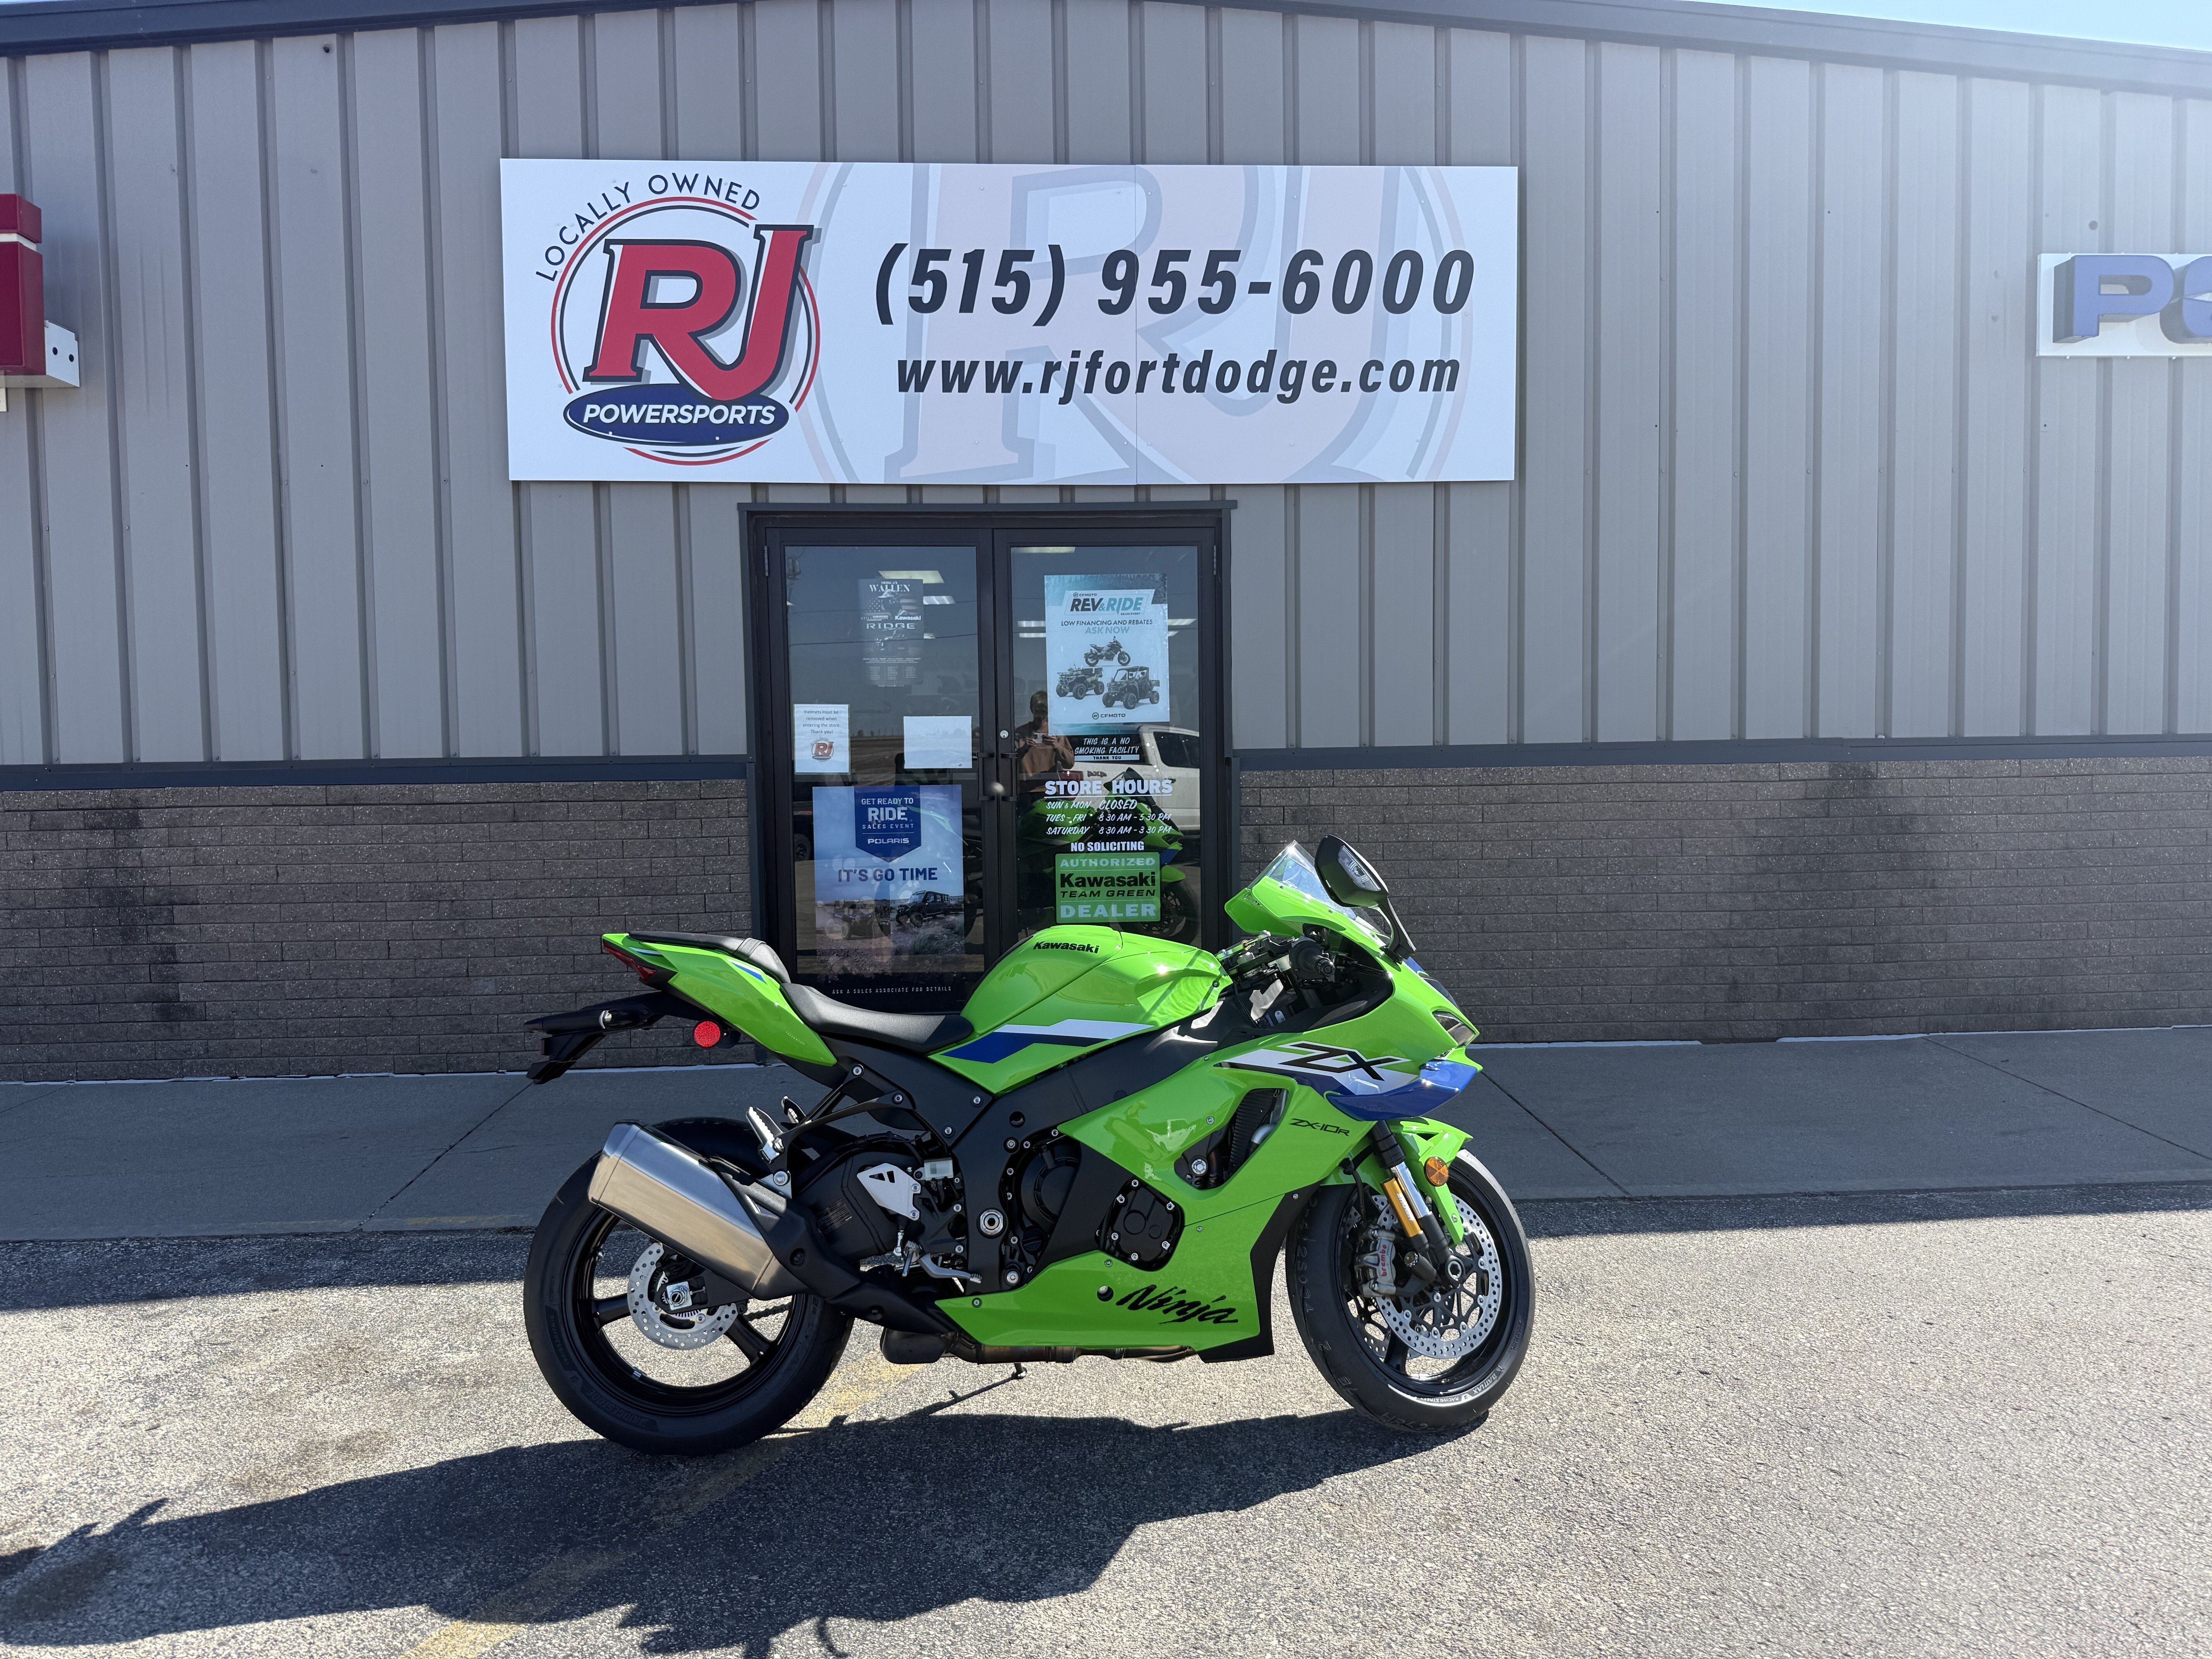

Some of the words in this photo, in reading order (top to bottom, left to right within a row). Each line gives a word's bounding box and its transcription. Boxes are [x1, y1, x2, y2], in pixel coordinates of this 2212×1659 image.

[536, 182, 632, 282] LOCALLY
[649, 173, 760, 210] OWNED
[876, 243, 1065, 326] (515)
[1098, 249, 1474, 315] 955-6000
[582, 224, 814, 404] RJ
[898, 349, 1460, 405] www.rjfortdodge.com
[583, 404, 776, 425] POWERSPORTS
[814, 741, 834, 757] RJ
[1109, 746, 1139, 754] FACILITY
[1045, 780, 1102, 795] STORE
[1112, 779, 1173, 794] HOURS
[1046, 801, 1064, 809] SUN
[1099, 799, 1138, 810] CLOSED
[868, 807, 908, 822] RIDE
[1046, 814, 1065, 822] TUES
[1073, 814, 1087, 822] FRI
[1117, 813, 1132, 821] AM
[1046, 826, 1091, 835] SATURDAY
[1117, 826, 1132, 834] AM
[1070, 842, 1085, 852] NO
[1087, 841, 1144, 852] SOLICITING
[1060, 857, 1156, 867] AUTHORIZED
[838, 869, 869, 883] IT'S
[873, 868, 895, 881] GO
[899, 867, 938, 881] TIME
[1060, 871, 1156, 888] Kawasaki
[1060, 903, 1156, 918] DEALER
[1033, 941, 1100, 954] Kawasaki
[1278, 1042, 1403, 1082] ZX
[1290, 1118, 1351, 1137] ZX-10R
[1116, 1284, 1239, 1325] Ninja
